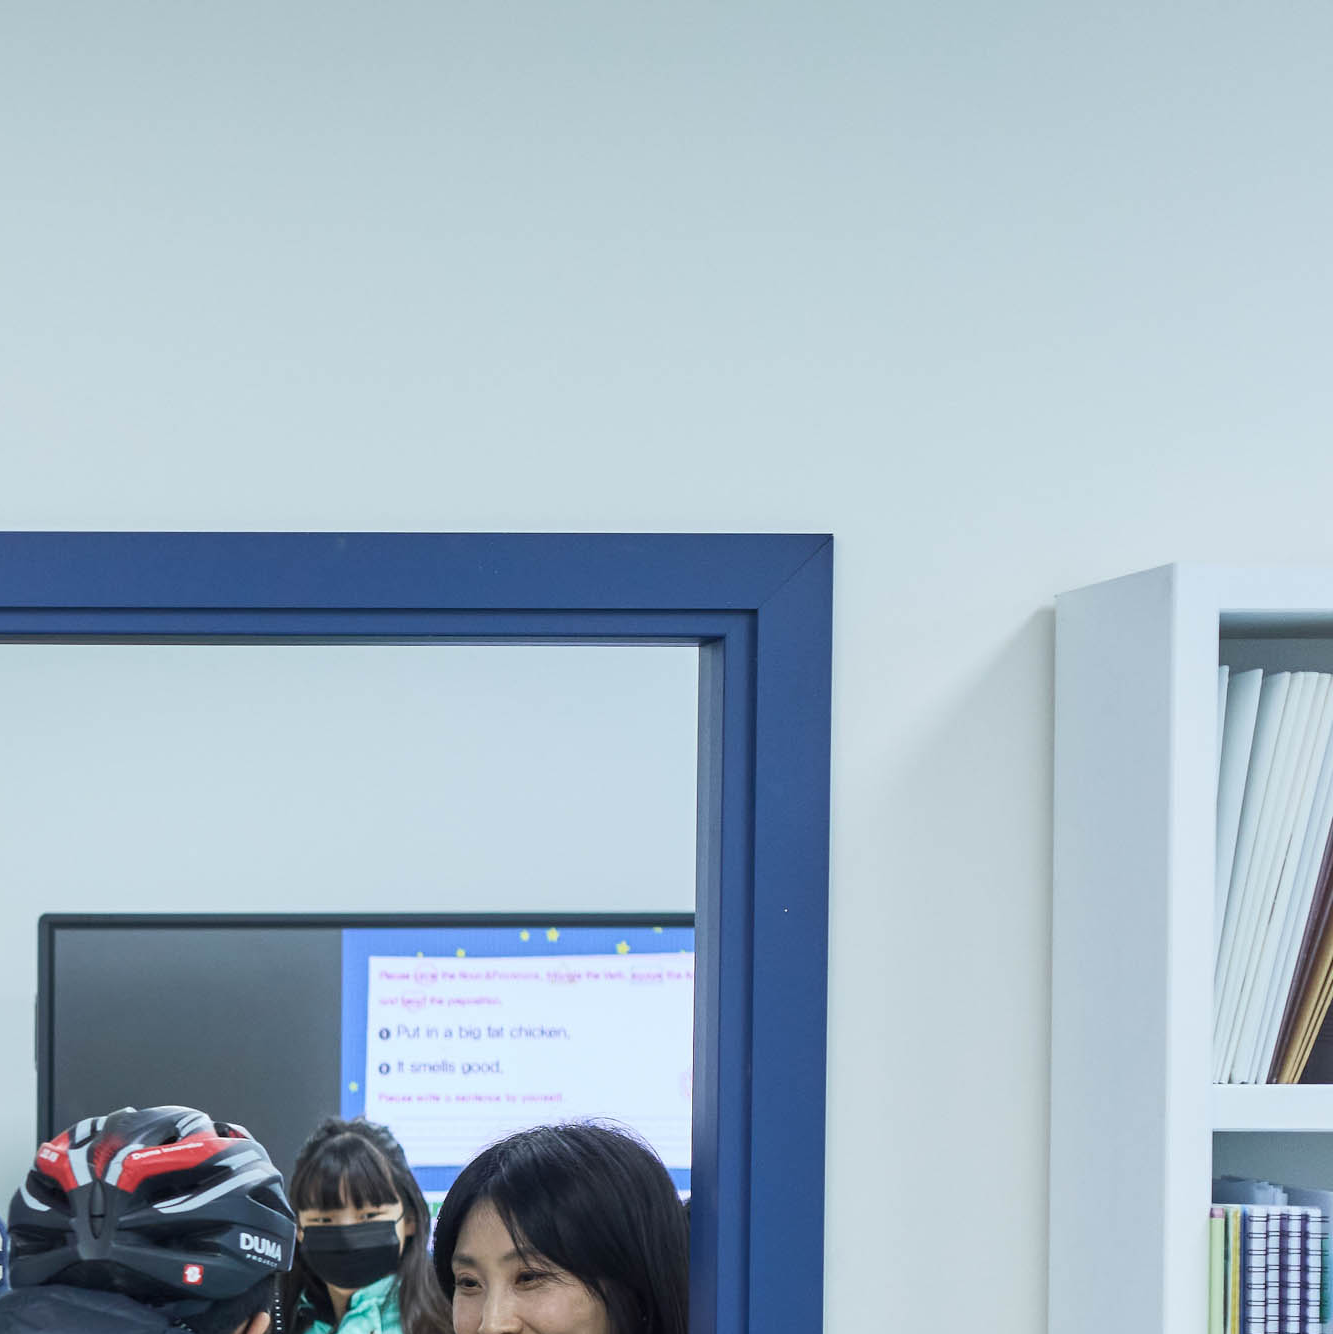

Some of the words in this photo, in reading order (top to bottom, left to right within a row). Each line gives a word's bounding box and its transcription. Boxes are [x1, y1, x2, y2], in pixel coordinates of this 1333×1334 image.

[397, 1024, 421, 1040] Put
[426, 1025, 439, 1040] in
[443, 1028, 454, 1040] a
[459, 1025, 482, 1043] big
[486, 1025, 506, 1040] fat
[397, 1060, 405, 1074] It
[410, 1060, 456, 1074] smells
[239, 1232, 282, 1262] DUMA
[245, 1253, 278, 1269] PROJECT
